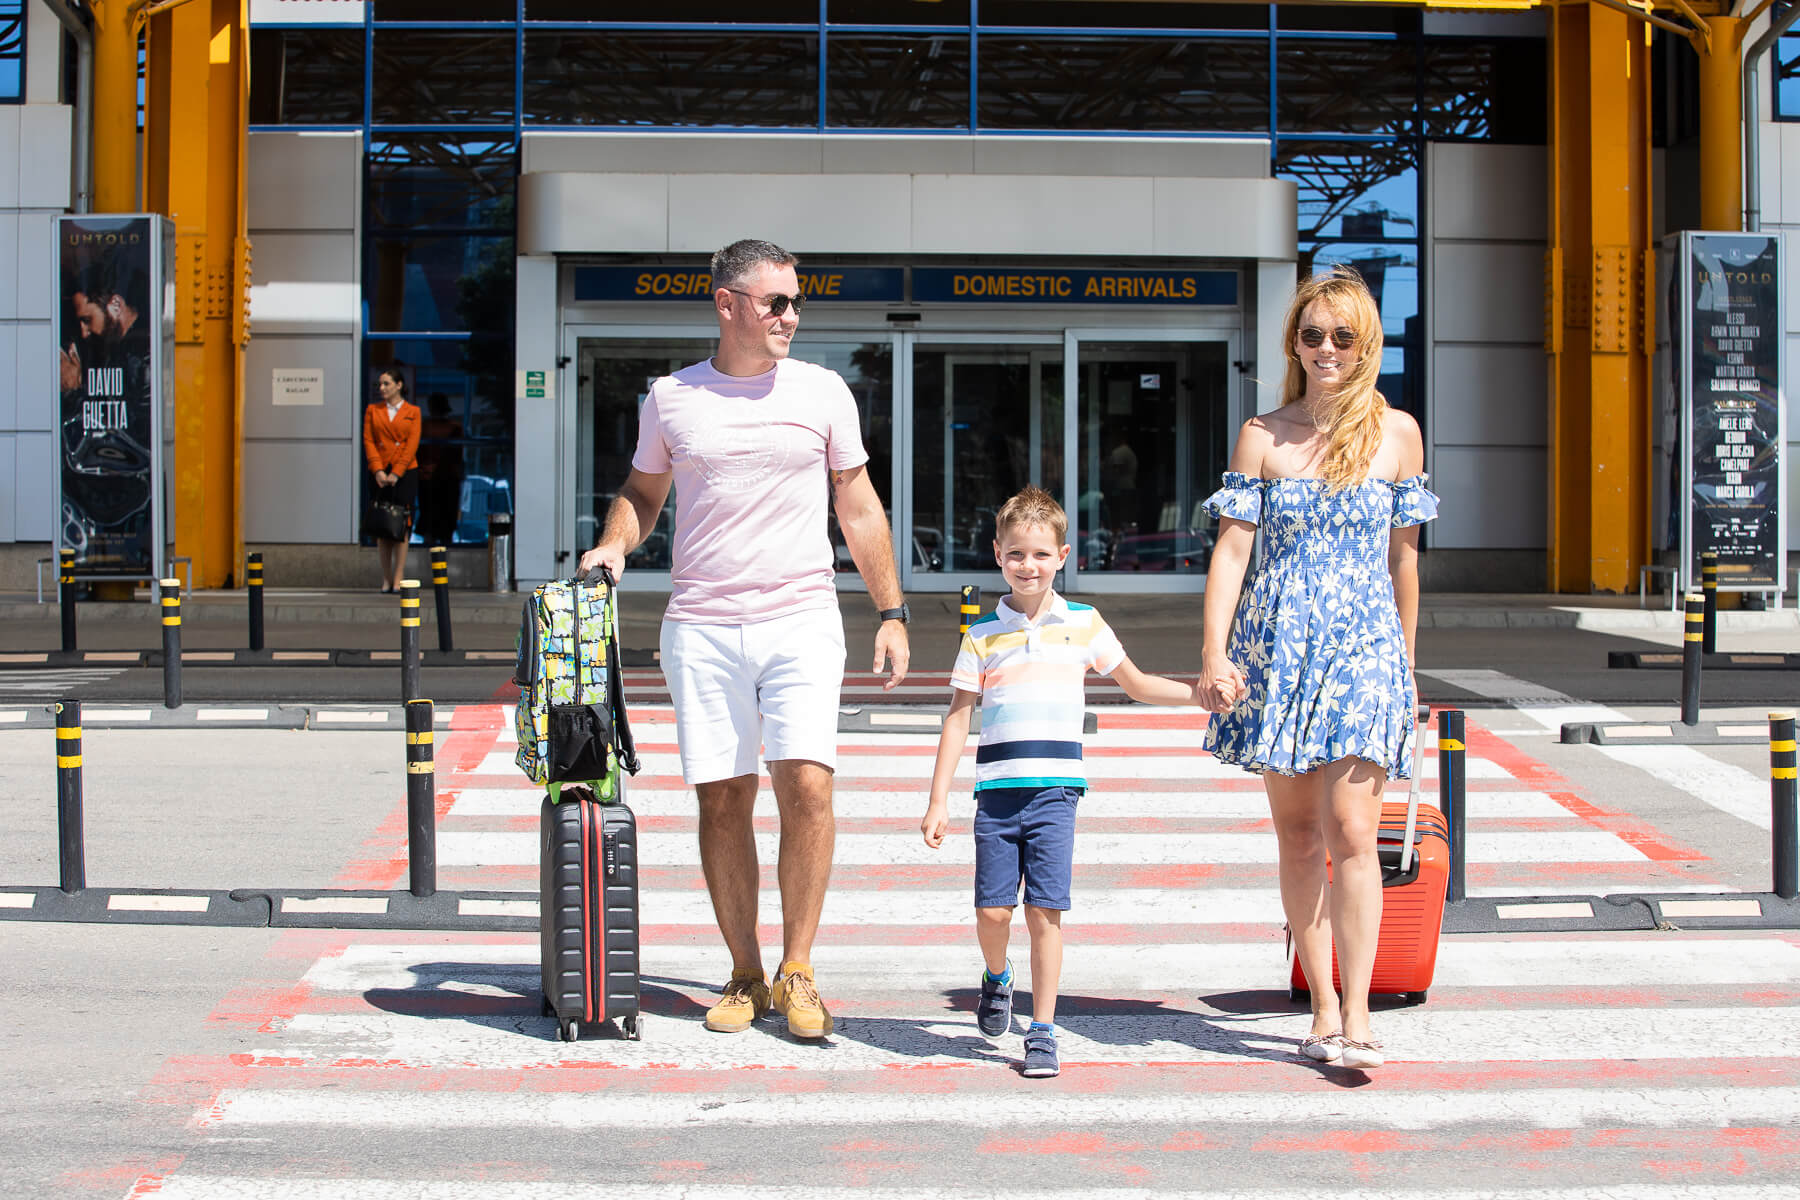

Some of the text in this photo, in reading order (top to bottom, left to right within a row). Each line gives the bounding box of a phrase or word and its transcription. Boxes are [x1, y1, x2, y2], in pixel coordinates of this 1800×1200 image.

[70, 233, 140, 246] UNTOLD
[635, 274, 714, 295] SOSIR
[953, 275, 1197, 298] DOMESTIC ARRIVALS
[1698, 272, 1772, 284] UNTOLD
[88, 367, 123, 396] DAVID
[83, 401, 128, 429] GUETTA
